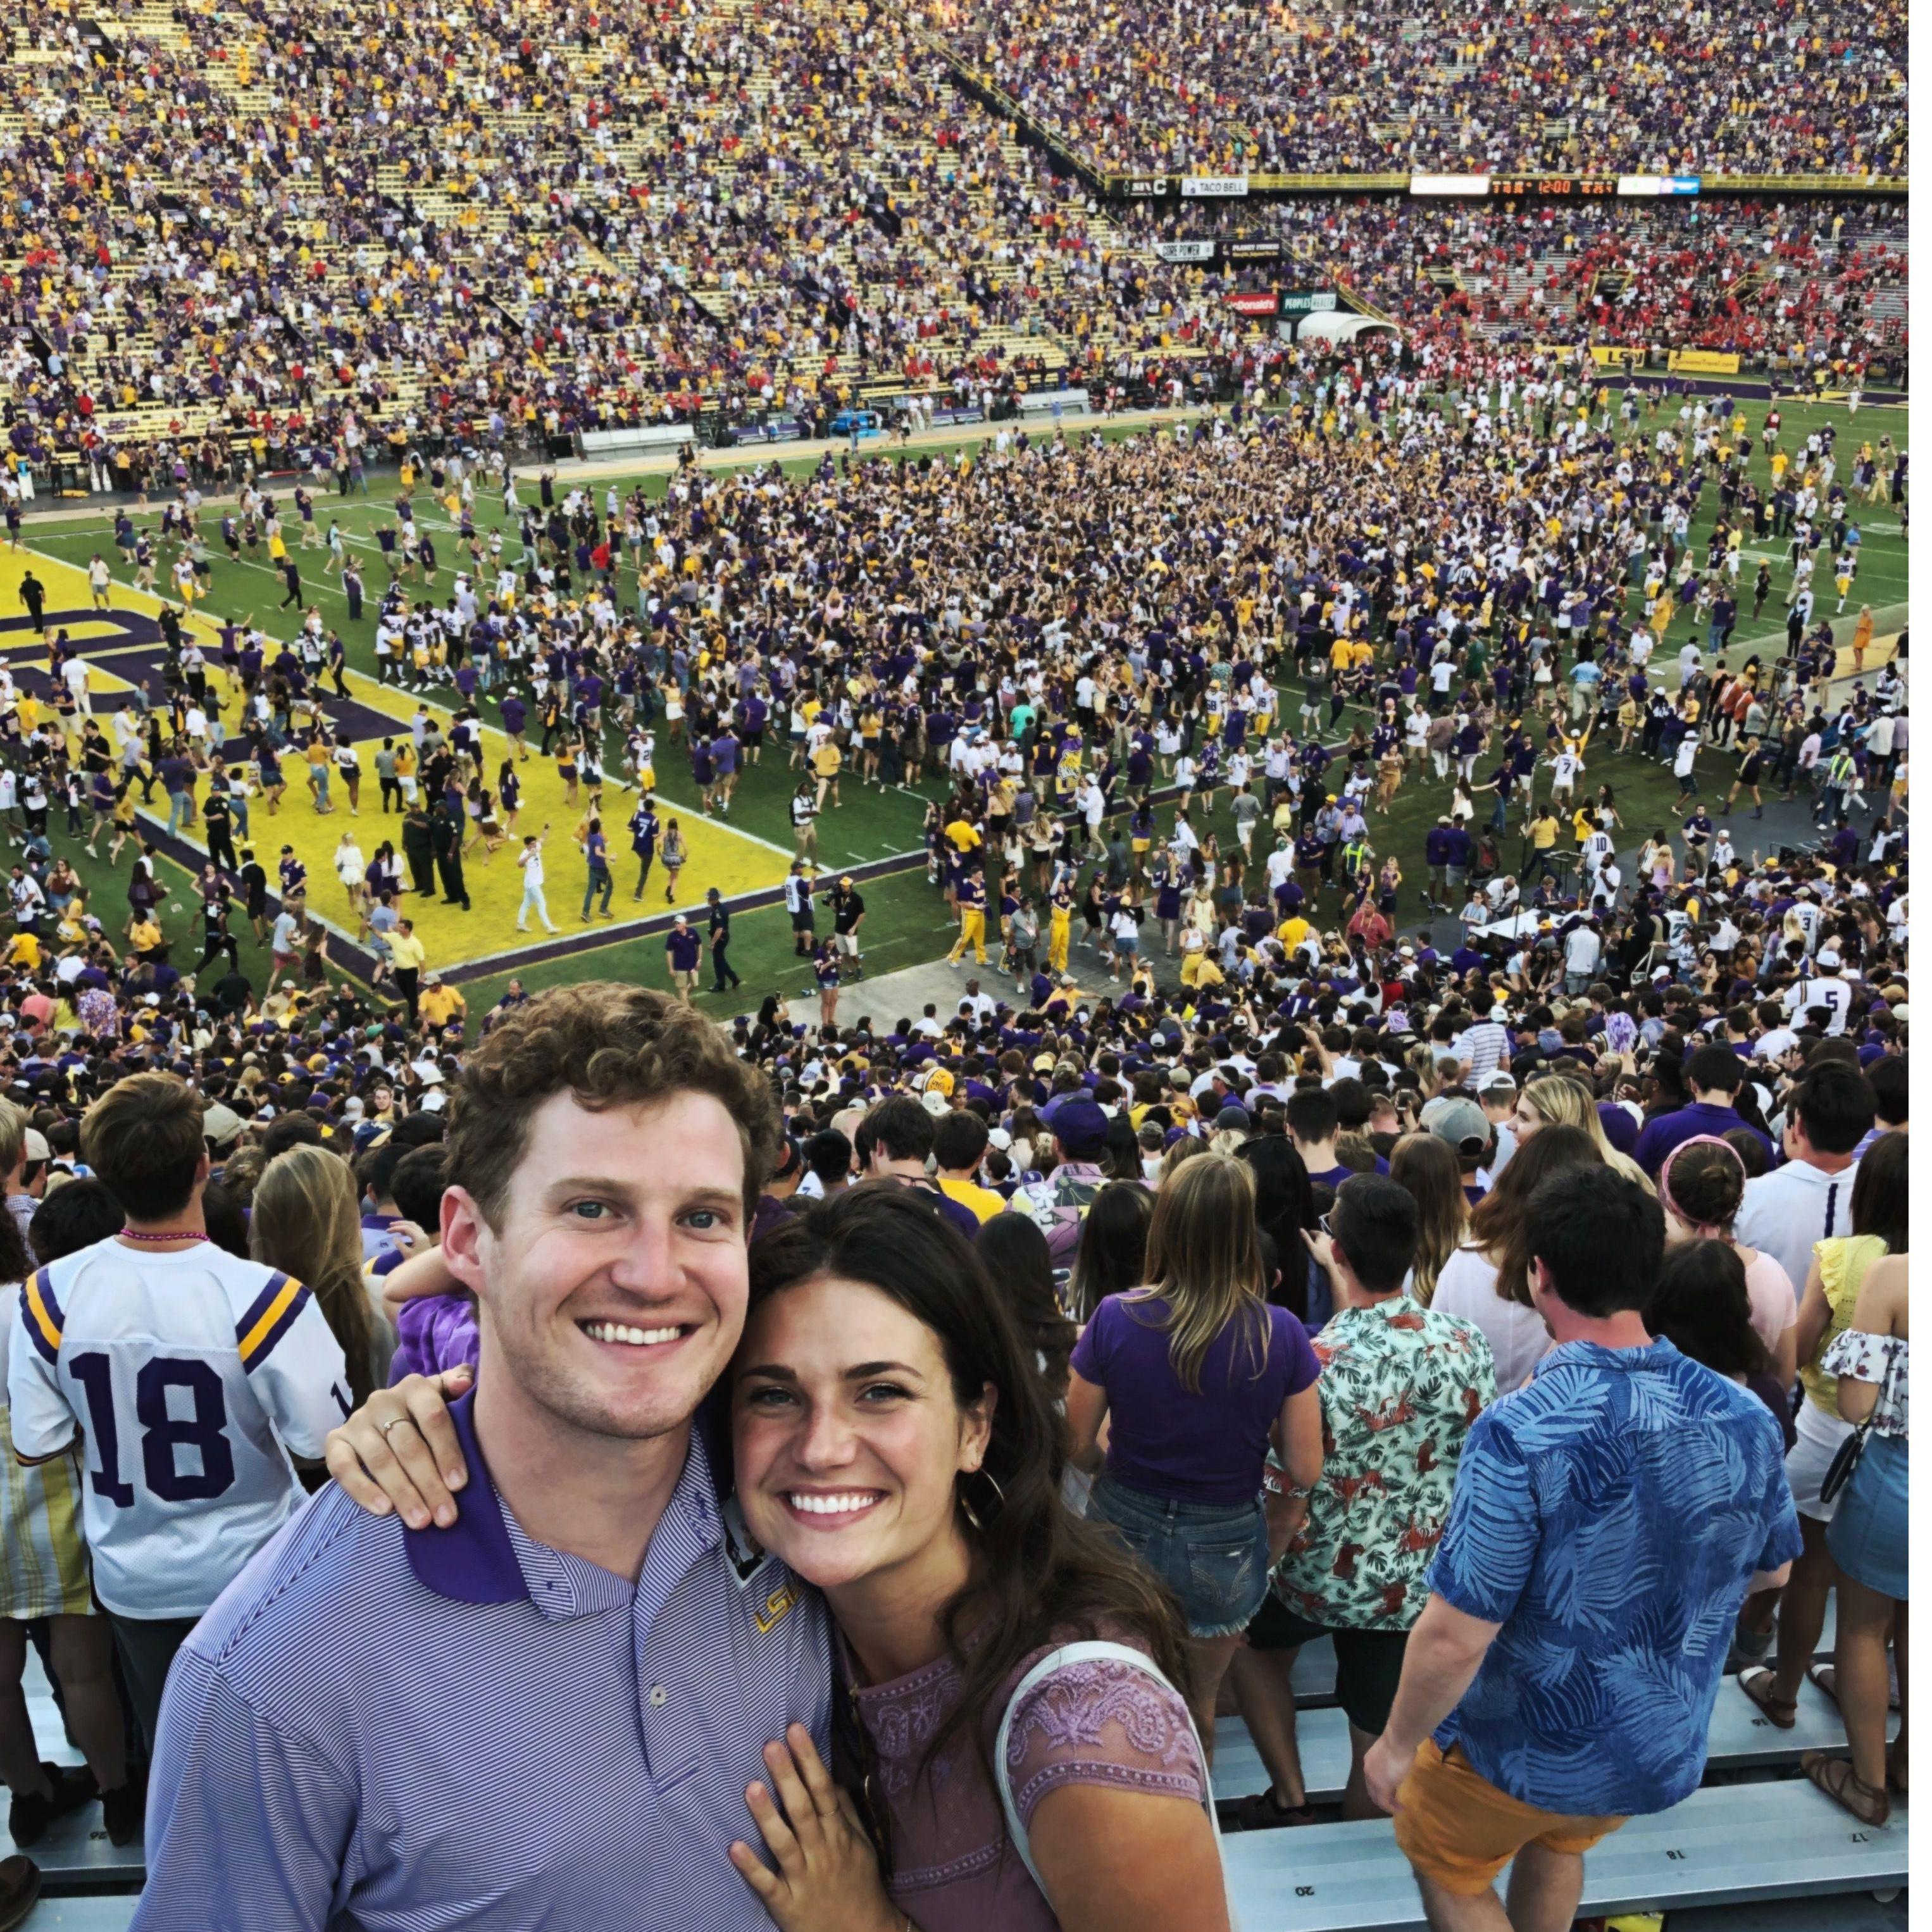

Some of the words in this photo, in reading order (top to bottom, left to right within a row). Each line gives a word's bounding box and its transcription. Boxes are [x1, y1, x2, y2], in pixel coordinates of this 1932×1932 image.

[1200, 183, 1221, 192] TACO
[1224, 182, 1243, 191] BELL
[1538, 181, 1571, 194] 12:00
[1162, 246, 1177, 256] CORE
[1180, 244, 1200, 254] POWER
[1384, 729, 1391, 740] 7
[1564, 762, 1571, 774] 7
[638, 823, 647, 837] 7
[1596, 837, 1607, 852] 10
[1802, 917, 1811, 931] 3
[1826, 991, 1838, 1013] 5
[68, 1352, 235, 1507] 18
[1852, 1833, 1869, 1843] 17
[1666, 1849, 1685, 1860] 18
[1295, 1886, 1314, 1897] 20
